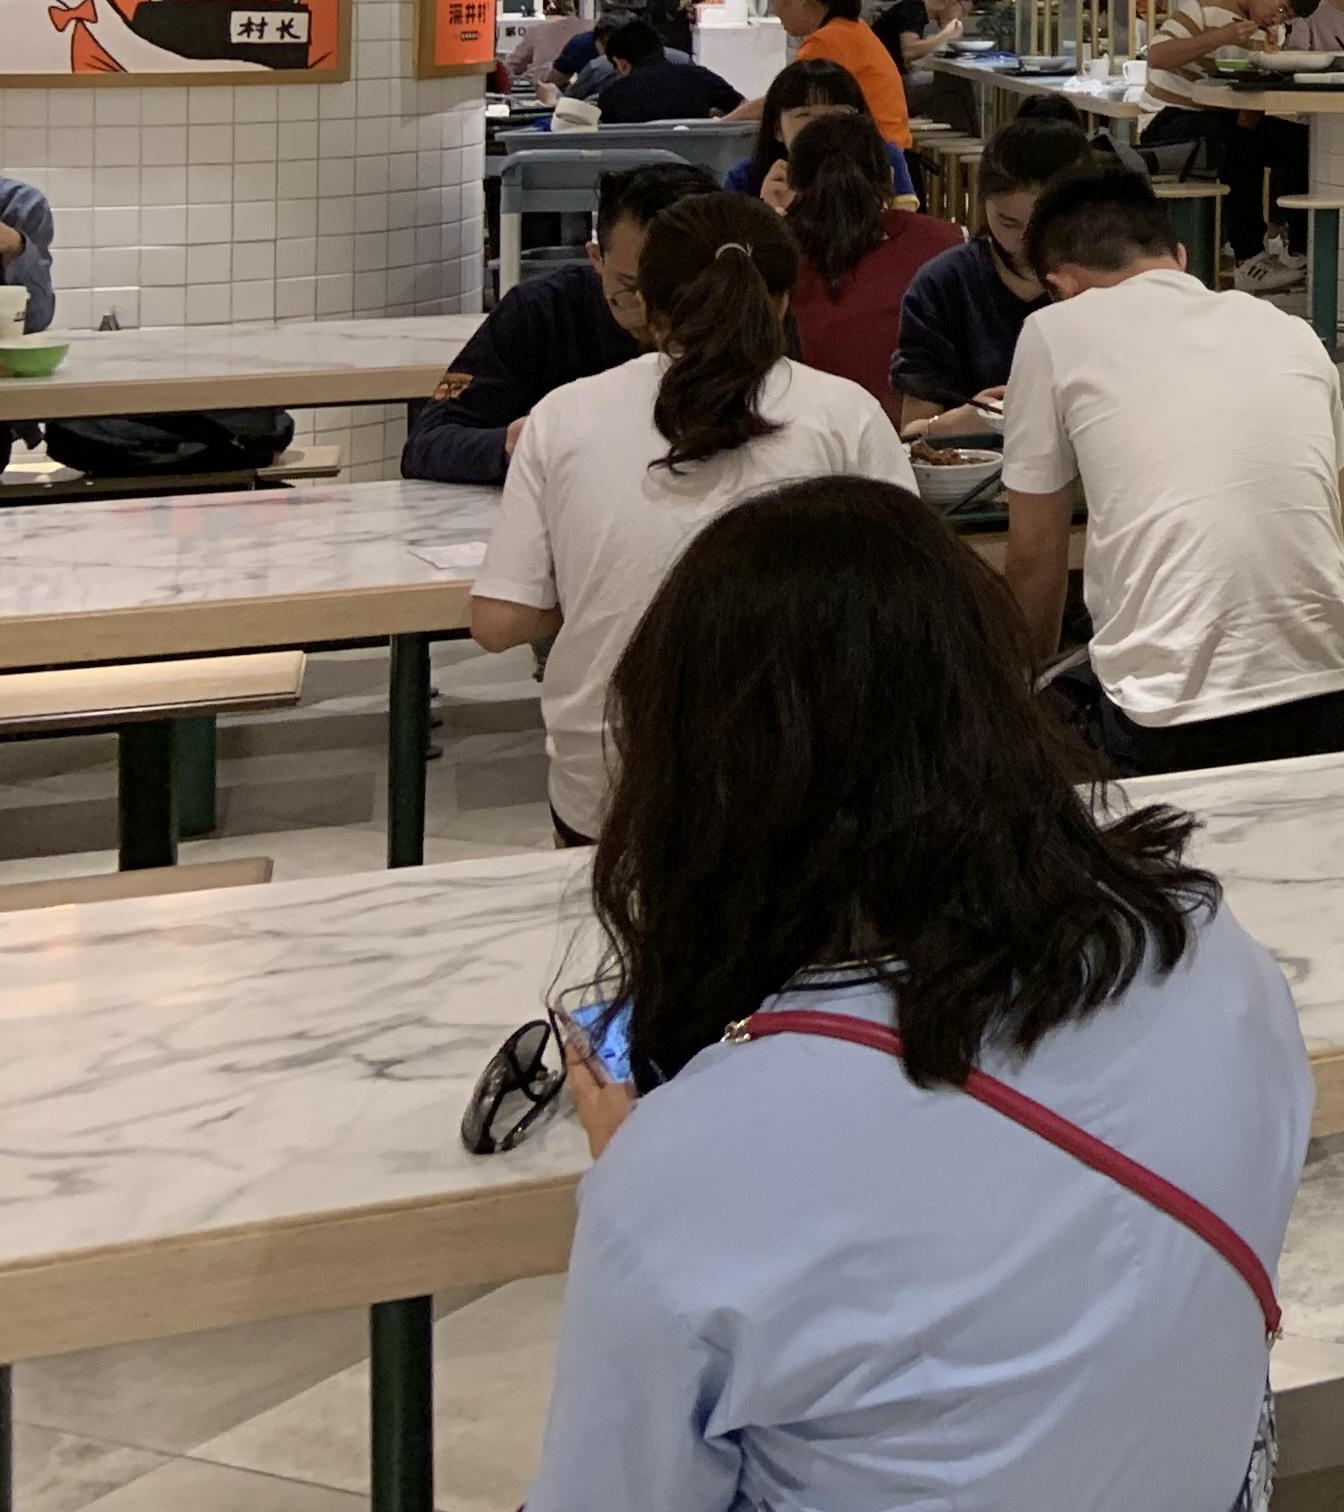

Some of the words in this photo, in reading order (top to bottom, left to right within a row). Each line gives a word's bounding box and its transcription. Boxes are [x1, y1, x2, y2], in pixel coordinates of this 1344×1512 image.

[448, 2, 487, 25] 深井村
[237, 17, 301, 41] 村长
